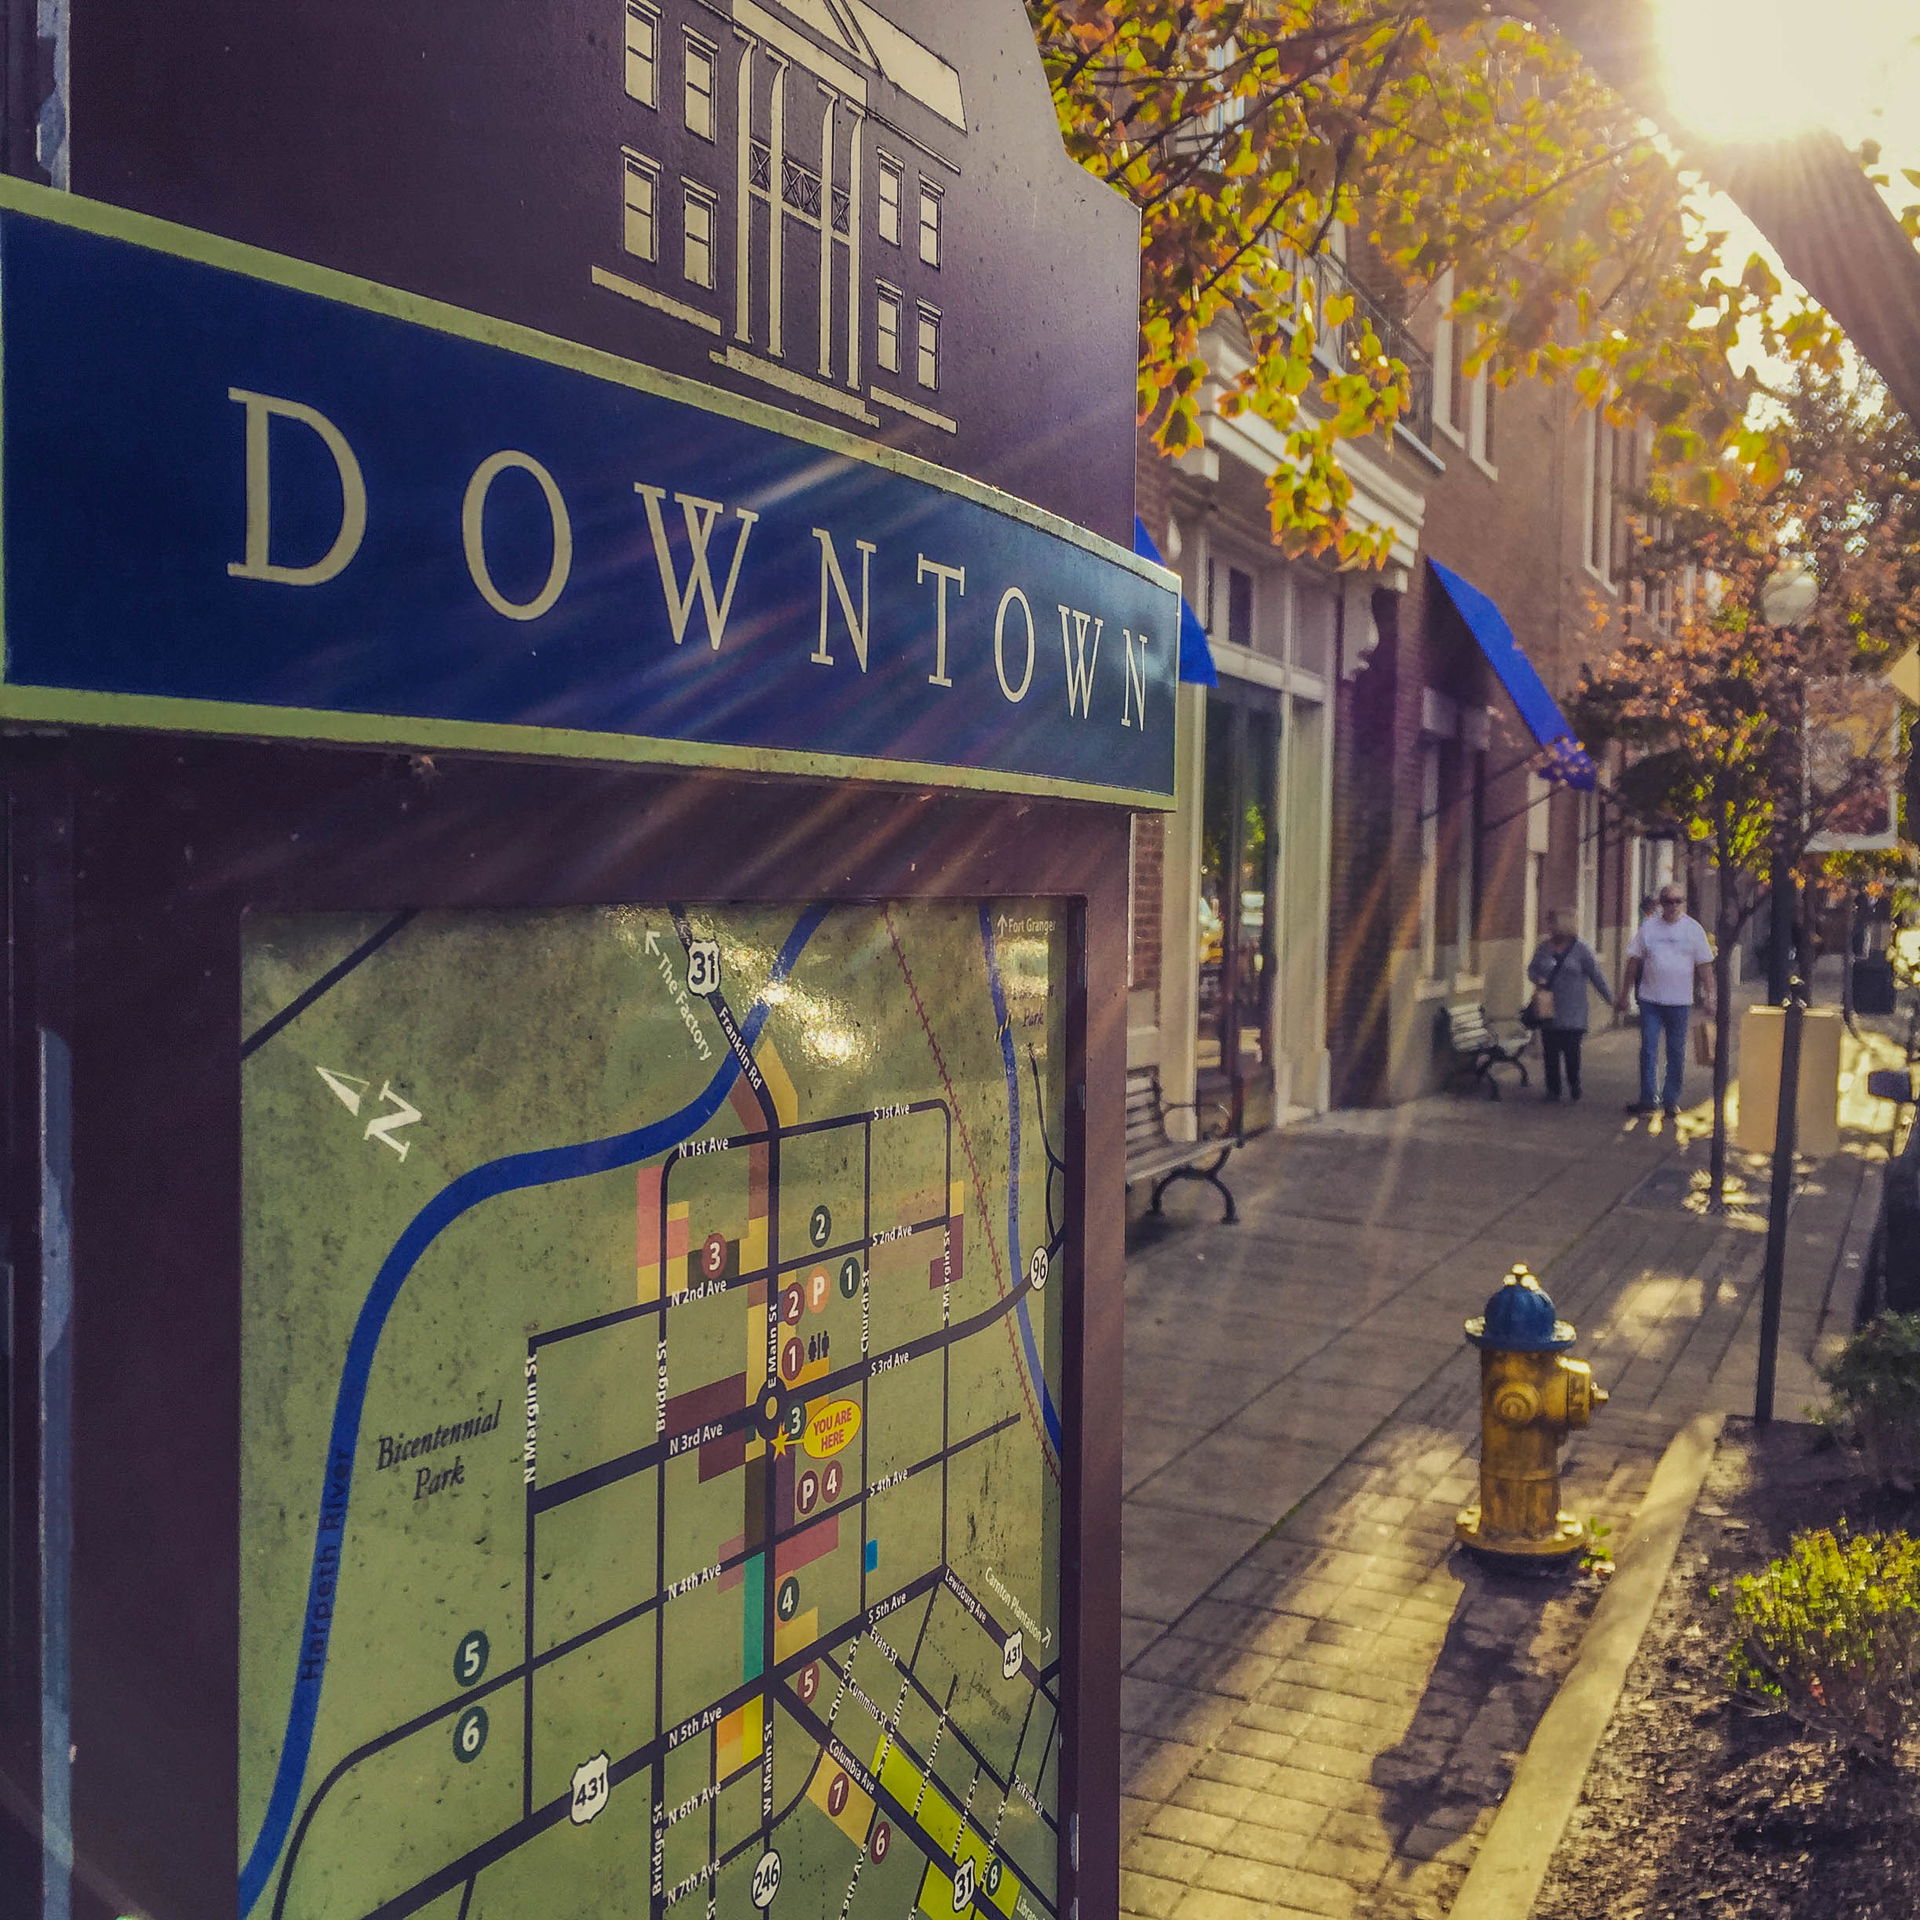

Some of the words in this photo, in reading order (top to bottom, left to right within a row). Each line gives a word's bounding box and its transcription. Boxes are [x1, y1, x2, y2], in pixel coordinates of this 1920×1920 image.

[228, 387, 1148, 731] DOWNTOWN
[1008, 918, 1024, 933] Fort
[1026, 917, 1056, 935] Granger
[691, 950, 715, 985] 31
[658, 952, 678, 995] The
[675, 990, 712, 1061] Factory
[719, 1006, 750, 1069] Franklin
[748, 1065, 762, 1090] Rd
[363, 1080, 422, 1162] N
[874, 1108, 879, 1122] S
[881, 1107, 893, 1119] 1st
[894, 1103, 910, 1117] Ave
[678, 1143, 688, 1159] N
[691, 1143, 706, 1157] 1st
[709, 1136, 729, 1154] Ave
[815, 1213, 826, 1241] 2
[872, 1234, 879, 1247] S
[879, 1228, 896, 1245] 2nd
[897, 1225, 913, 1239] Ave
[943, 1229, 950, 1246] St
[709, 1242, 721, 1271] 3
[1032, 1253, 1047, 1281] 96
[813, 1276, 825, 1306] P
[845, 1265, 853, 1291] 1
[861, 1269, 870, 1287] St
[943, 1251, 951, 1308] Margin
[671, 1289, 681, 1307] N
[682, 1282, 705, 1303] 2nd
[706, 1279, 728, 1297] Ave
[788, 1290, 799, 1318] 2
[768, 1303, 778, 1323] St
[860, 1291, 870, 1353] Church
[943, 1311, 950, 1321] S
[656, 1339, 668, 1361] St
[768, 1327, 778, 1372] Main
[788, 1345, 796, 1373] 1
[870, 1362, 877, 1377] S
[878, 1357, 892, 1374] 3rd
[893, 1351, 910, 1367] Ave
[524, 1353, 537, 1378] St
[767, 1376, 777, 1389] E
[655, 1365, 669, 1433] Bridge
[375, 1399, 503, 1471] Bicentennial
[524, 1382, 539, 1462] Margin
[790, 1407, 801, 1435] 3
[813, 1417, 833, 1436] YOU
[834, 1407, 853, 1428] ARE
[669, 1439, 679, 1456] N
[681, 1428, 700, 1450] 3rd
[702, 1422, 723, 1443] Ave
[821, 1428, 845, 1452] HERE
[413, 1455, 465, 1501] Park
[523, 1466, 536, 1485] N
[826, 1468, 838, 1494] 4
[869, 1482, 876, 1497] S
[877, 1474, 892, 1493] 4th
[892, 1468, 908, 1486] Ave
[802, 1478, 815, 1510] P
[668, 1584, 677, 1601] N
[679, 1572, 698, 1592] 4th
[701, 1563, 722, 1585] Ave
[945, 1568, 975, 1613] Lewisburg
[973, 1603, 987, 1624] Ave
[781, 1586, 794, 1613] 4
[868, 1609, 874, 1624] S
[875, 1600, 890, 1620] 5th
[890, 1592, 907, 1610] Ave
[1010, 1595, 1042, 1642] Plantation
[463, 1640, 481, 1678] 5
[870, 1625, 890, 1657] Evans
[888, 1651, 898, 1667] St
[1005, 1643, 1021, 1666] 431
[803, 1668, 814, 1698] 5
[828, 1659, 853, 1721] Church
[849, 1636, 859, 1656] St
[848, 1677, 880, 1721] Cummins
[878, 1711, 888, 1728] St
[939, 1708, 949, 1726] St
[669, 1729, 678, 1749] N
[681, 1718, 699, 1742] 5th
[702, 1707, 722, 1729] Ave
[763, 1721, 773, 1742] St
[882, 1698, 904, 1758] Margin
[901, 1678, 910, 1695] St
[462, 1716, 480, 1752] 6
[763, 1745, 773, 1792] Main
[829, 1738, 861, 1780] Columbia
[861, 1772, 875, 1795] Ave
[575, 1772, 605, 1807] 431
[834, 1780, 844, 1809] 7
[969, 1779, 978, 1795] St
[652, 1801, 663, 1825] St
[668, 1808, 677, 1827] N
[680, 1796, 699, 1819] 6th
[701, 1782, 721, 1806] Ave
[763, 1797, 772, 1817] W
[998, 1800, 1007, 1815] St
[876, 1829, 886, 1856] 6
[652, 1828, 665, 1897] Bridge
[842, 1881, 857, 1911] 9th
[854, 1843, 868, 1876] Ave
[989, 1865, 998, 1889] 8
[668, 1887, 676, 1907] N
[679, 1873, 698, 1899] 7th
[700, 1858, 721, 1883] Ave
[754, 1860, 779, 1900] 246
[956, 1866, 972, 1904] 31
[706, 1898, 716, 1920] St
